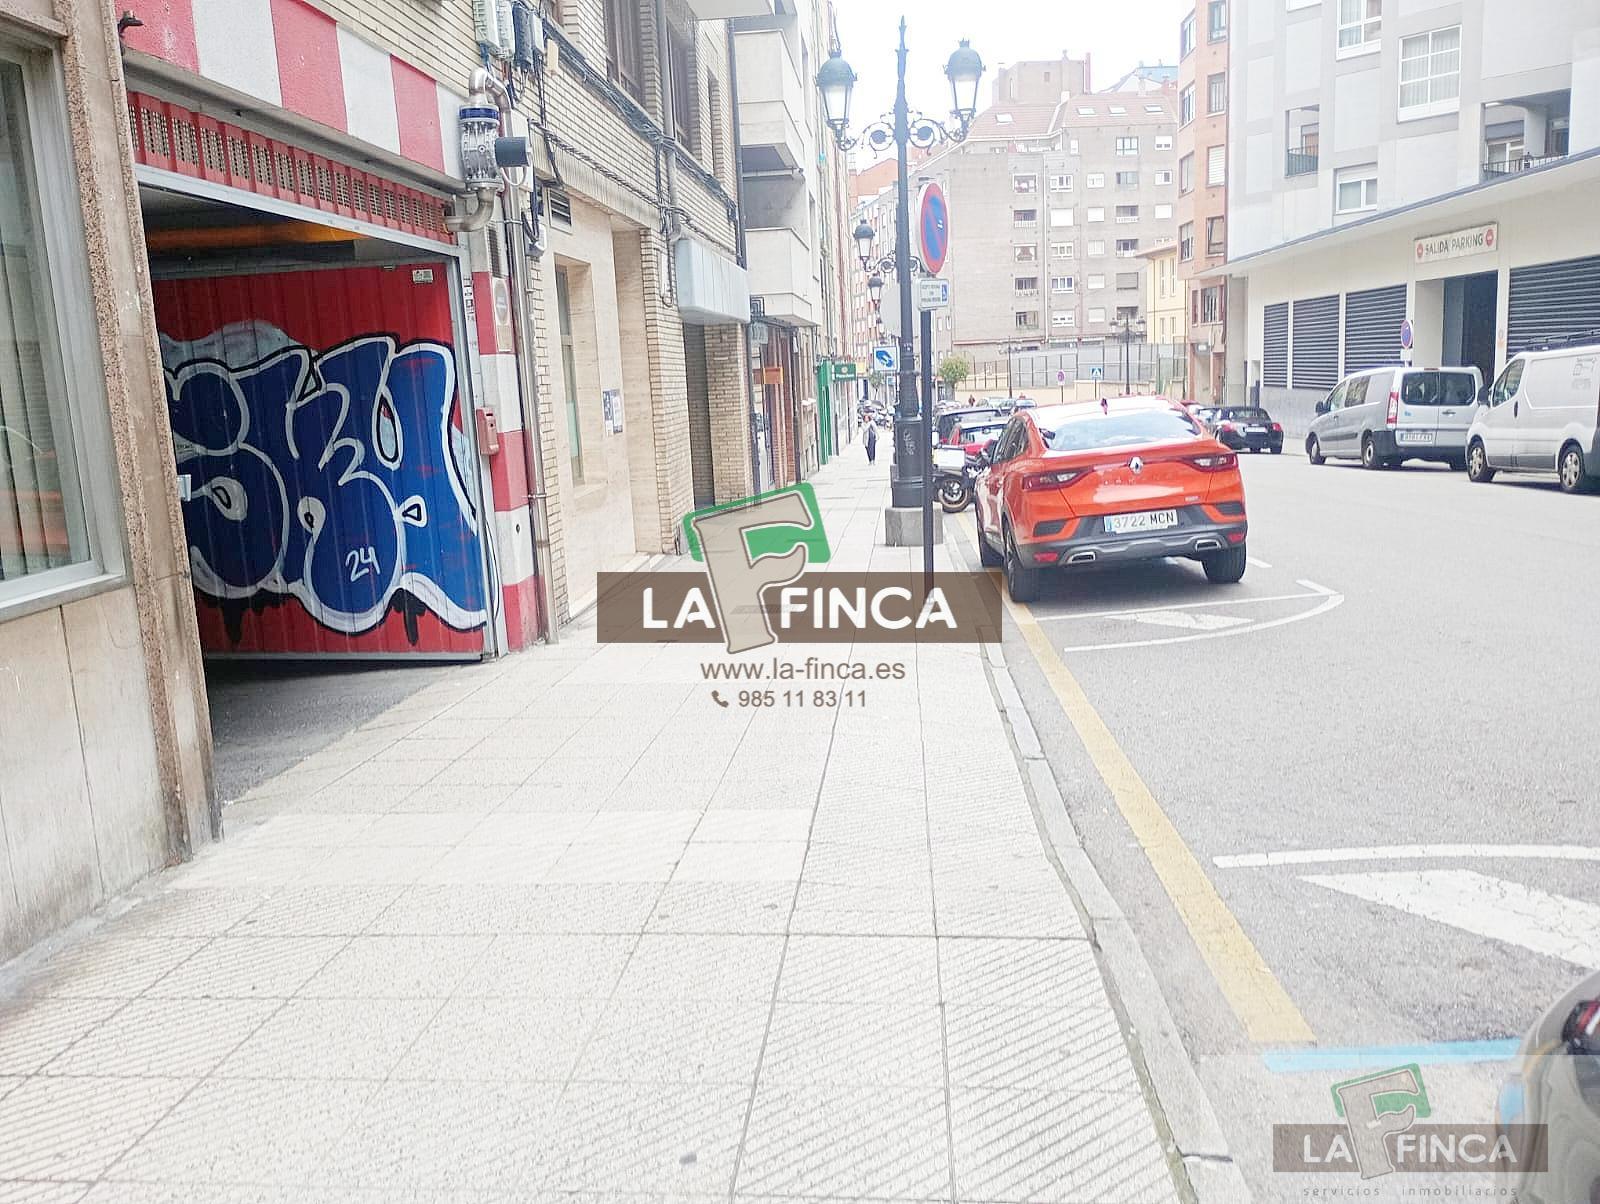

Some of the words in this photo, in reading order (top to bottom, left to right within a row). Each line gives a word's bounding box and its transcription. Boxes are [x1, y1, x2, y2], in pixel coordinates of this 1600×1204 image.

[1425, 240, 1449, 256] SALIDA
[1451, 233, 1484, 249] PARKING
[1114, 516, 1146, 529] 3722
[1150, 511, 1175, 525] MCN
[345, 546, 381, 582] 24
